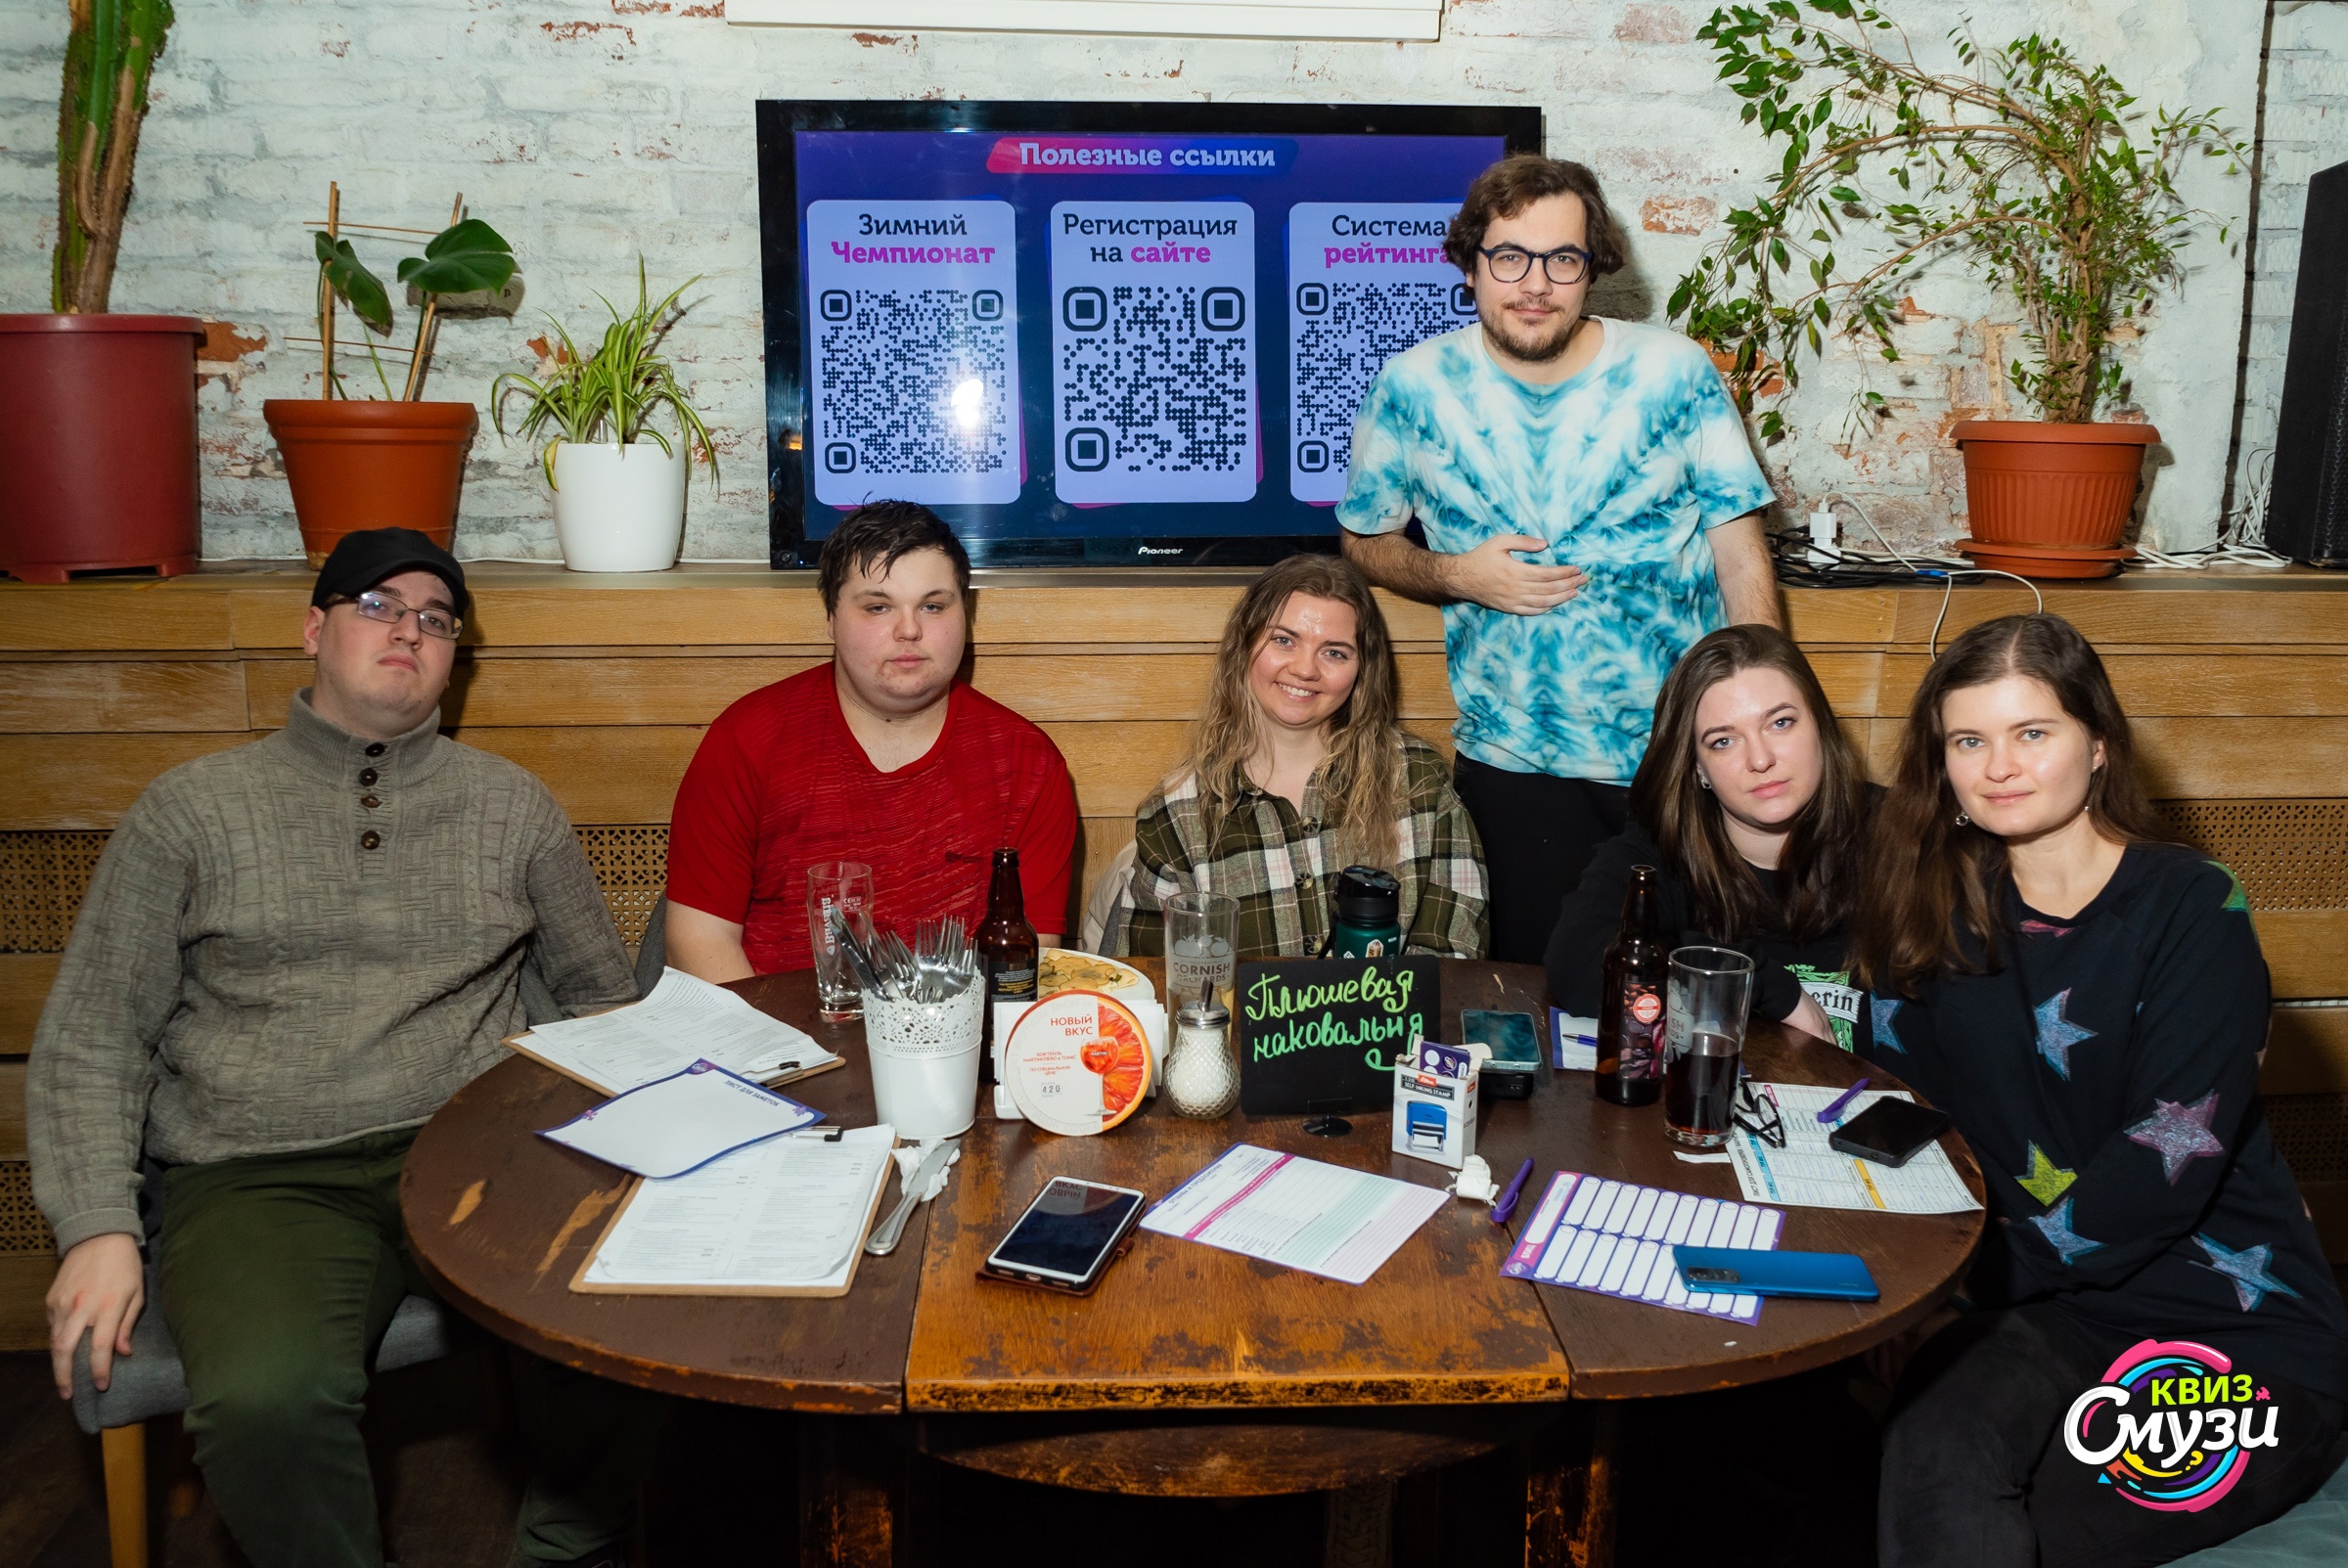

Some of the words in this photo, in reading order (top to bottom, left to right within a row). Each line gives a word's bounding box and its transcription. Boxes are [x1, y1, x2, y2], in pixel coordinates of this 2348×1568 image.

[1019, 142, 1162, 167] Полезные
[1169, 147, 1276, 167] ссылки
[858, 212, 967, 236] Зимний
[1062, 213, 1238, 241] Регистрация
[1332, 214, 1448, 237] Система
[831, 241, 996, 263] Чемпионат
[1090, 245, 1123, 262] на
[1130, 240, 1211, 263] сайте
[1138, 546, 1183, 556] Pioneer
[1173, 962, 1231, 975] CORNISH
[1244, 965, 1415, 1021] Плюшевая
[1811, 989, 1854, 1013] erin
[1050, 1013, 1093, 1026] НОВЫЙ
[1064, 1026, 1093, 1037] ВКУС
[1253, 1011, 1423, 1071] наковальня
